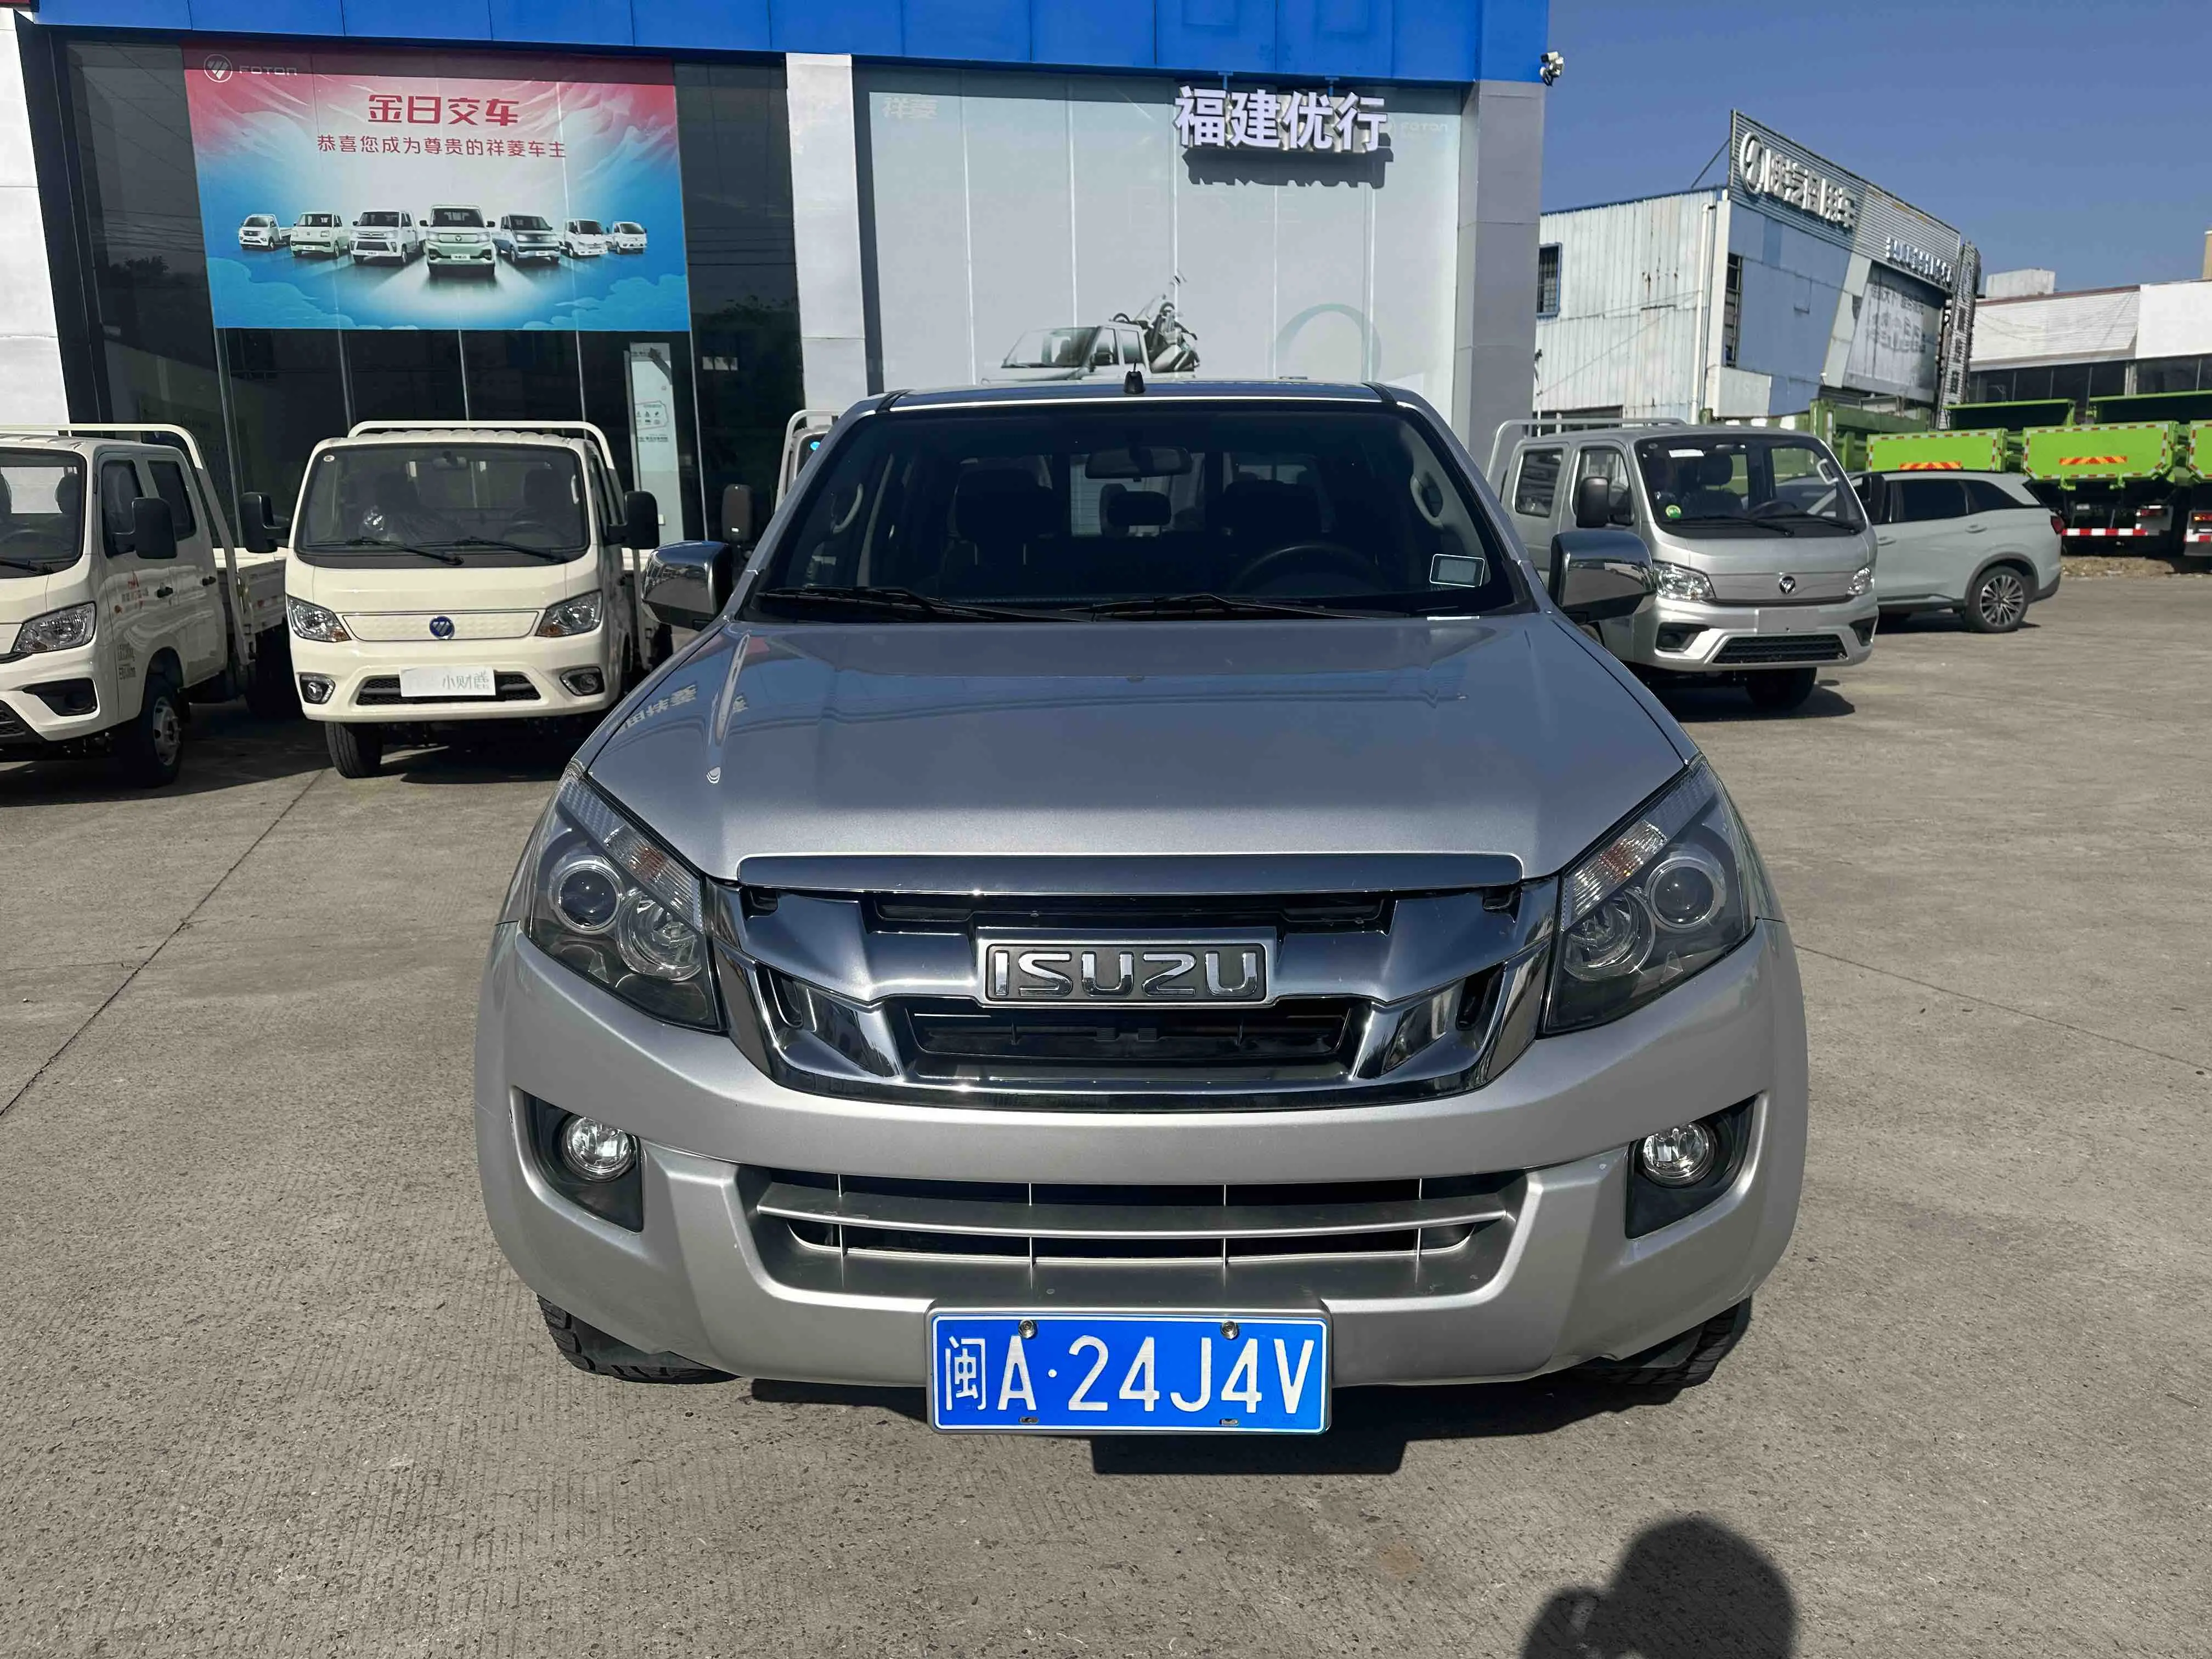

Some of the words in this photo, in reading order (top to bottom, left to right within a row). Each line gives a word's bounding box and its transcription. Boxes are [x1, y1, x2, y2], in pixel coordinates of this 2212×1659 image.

[368, 94, 520, 127] 金日交车
[1175, 86, 1388, 151] 福建优行
[317, 134, 567, 158] 恭喜您成为尊贵的祥菱车主
[994, 950, 1258, 997] ISUZU
[945, 1335, 1314, 1414] 闽A·24J4V
